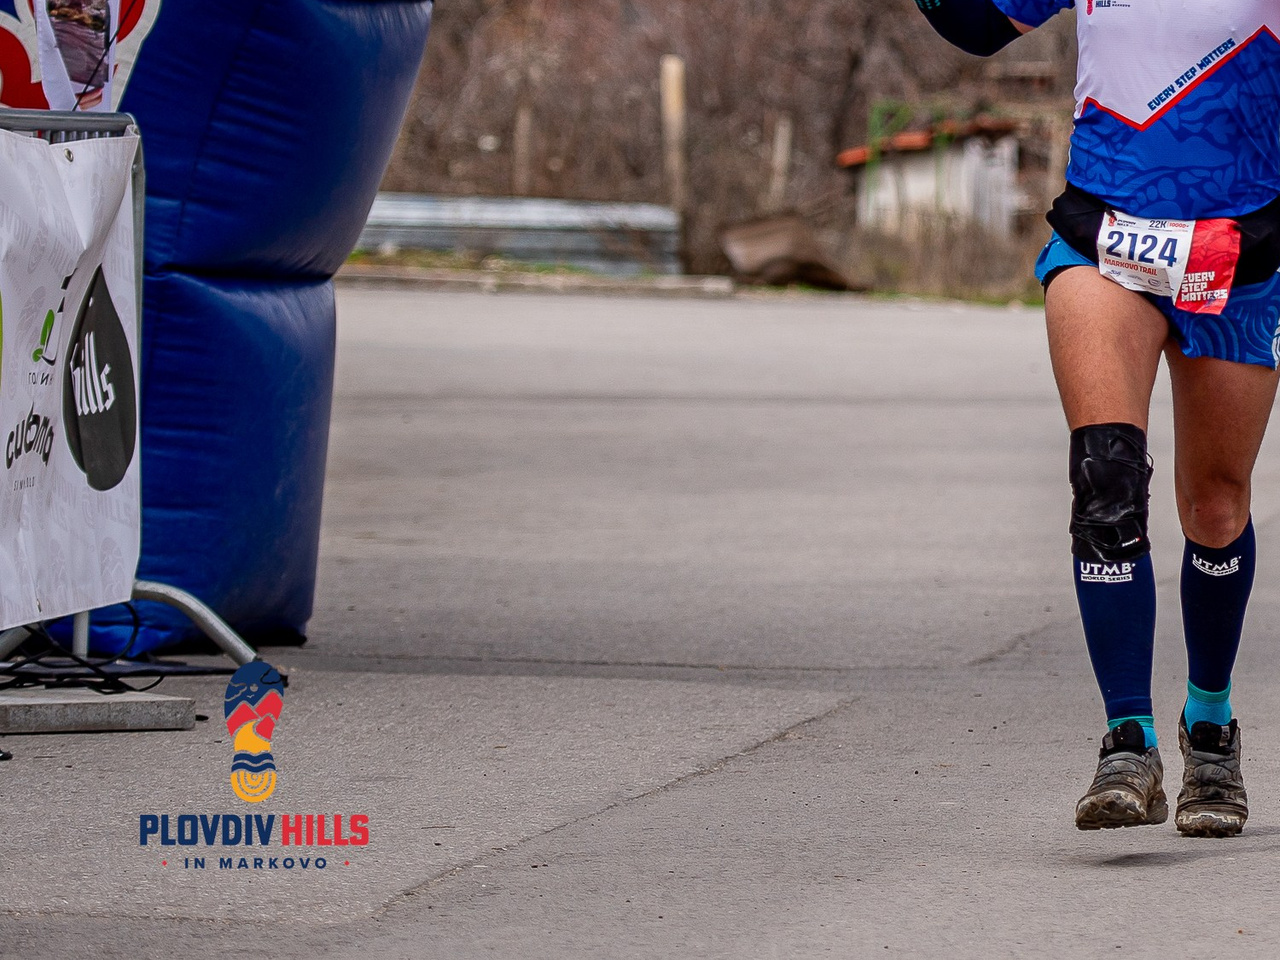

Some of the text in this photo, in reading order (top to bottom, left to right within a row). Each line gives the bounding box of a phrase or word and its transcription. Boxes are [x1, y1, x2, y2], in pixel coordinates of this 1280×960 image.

[1147, 38, 1236, 111] EVERY STEP MATTERS
[1149, 220, 1167, 229] 22K
[1106, 230, 1178, 267] 2124
[1104, 258, 1158, 276] MARKOVO TRAIL
[1181, 282, 1208, 293] STEP
[1181, 289, 1228, 302] MATTERS
[1080, 562, 1132, 575] UTMB
[1193, 553, 1239, 571] UTMB
